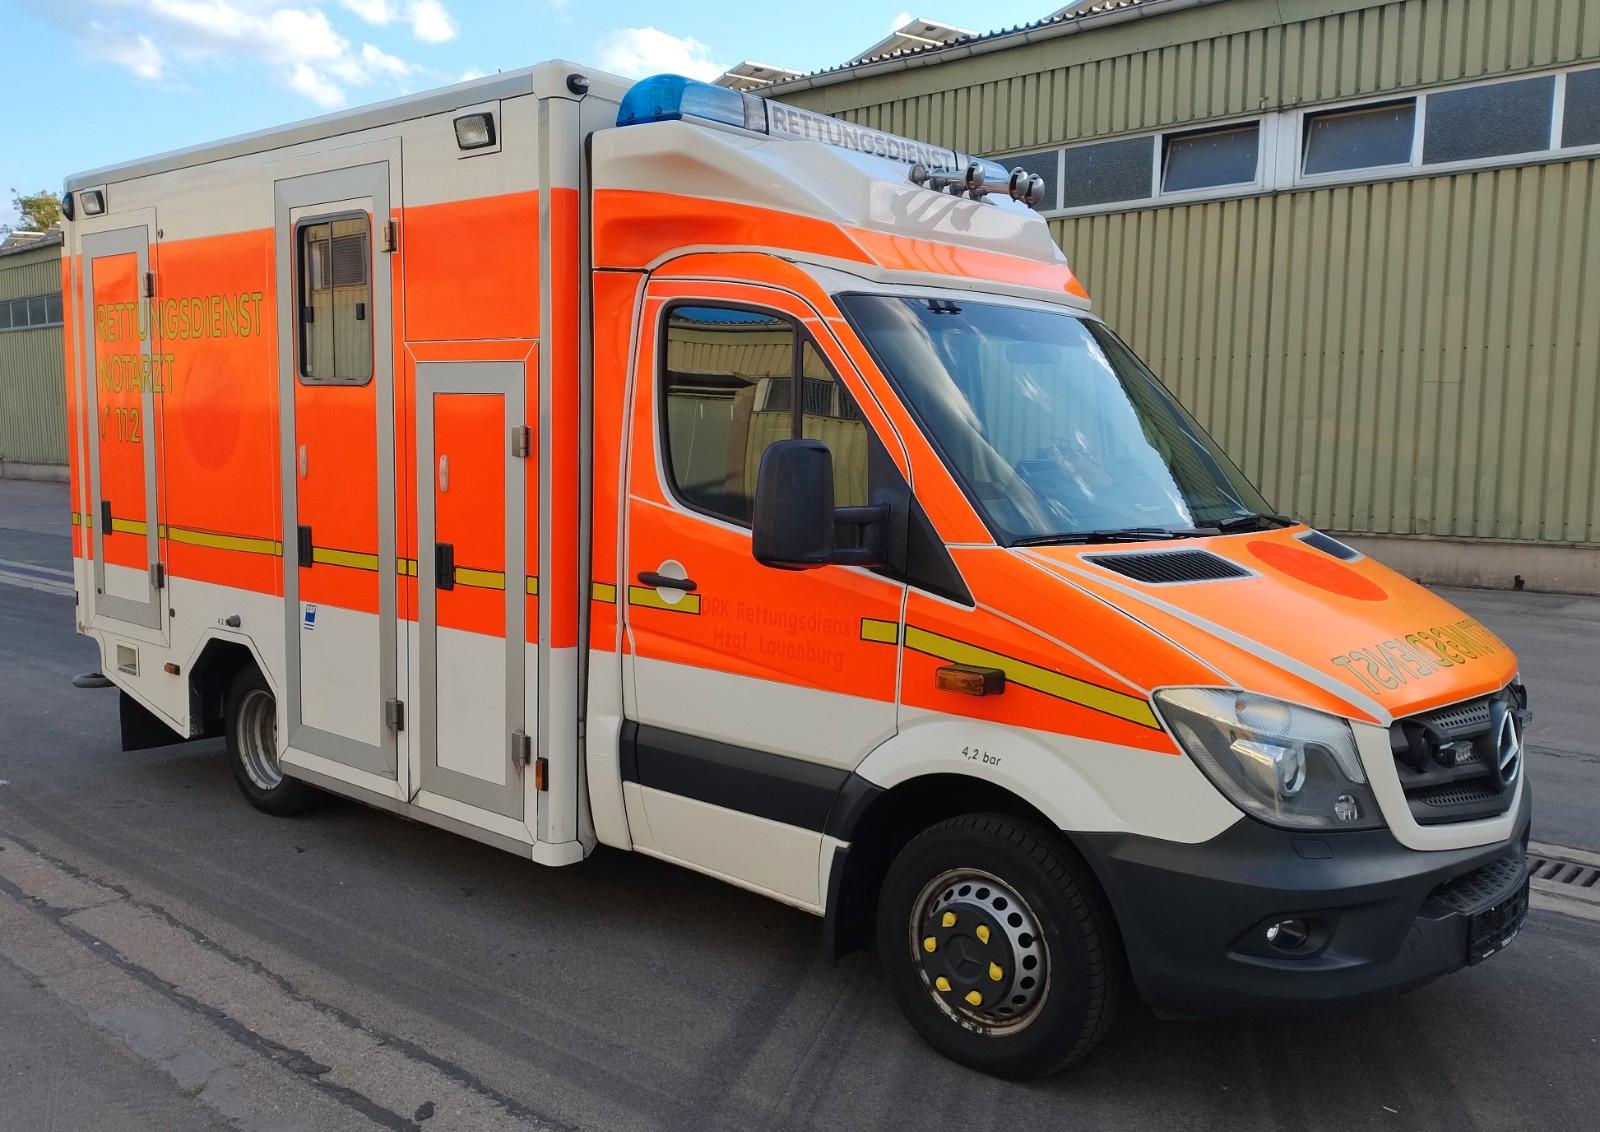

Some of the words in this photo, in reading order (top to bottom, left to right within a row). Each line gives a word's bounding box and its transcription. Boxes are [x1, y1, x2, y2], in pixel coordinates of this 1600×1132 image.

[772, 106, 950, 172] RETTUNGSDIENST
[97, 292, 263, 341] RETTUNGSDIENST
[100, 353, 174, 394] NOTARZT
[115, 408, 141, 443] 112
[703, 597, 730, 618] DRK
[759, 634, 844, 674] Lauenburg
[962, 746, 979, 760] 4,2
[982, 751, 1002, 767] bar
